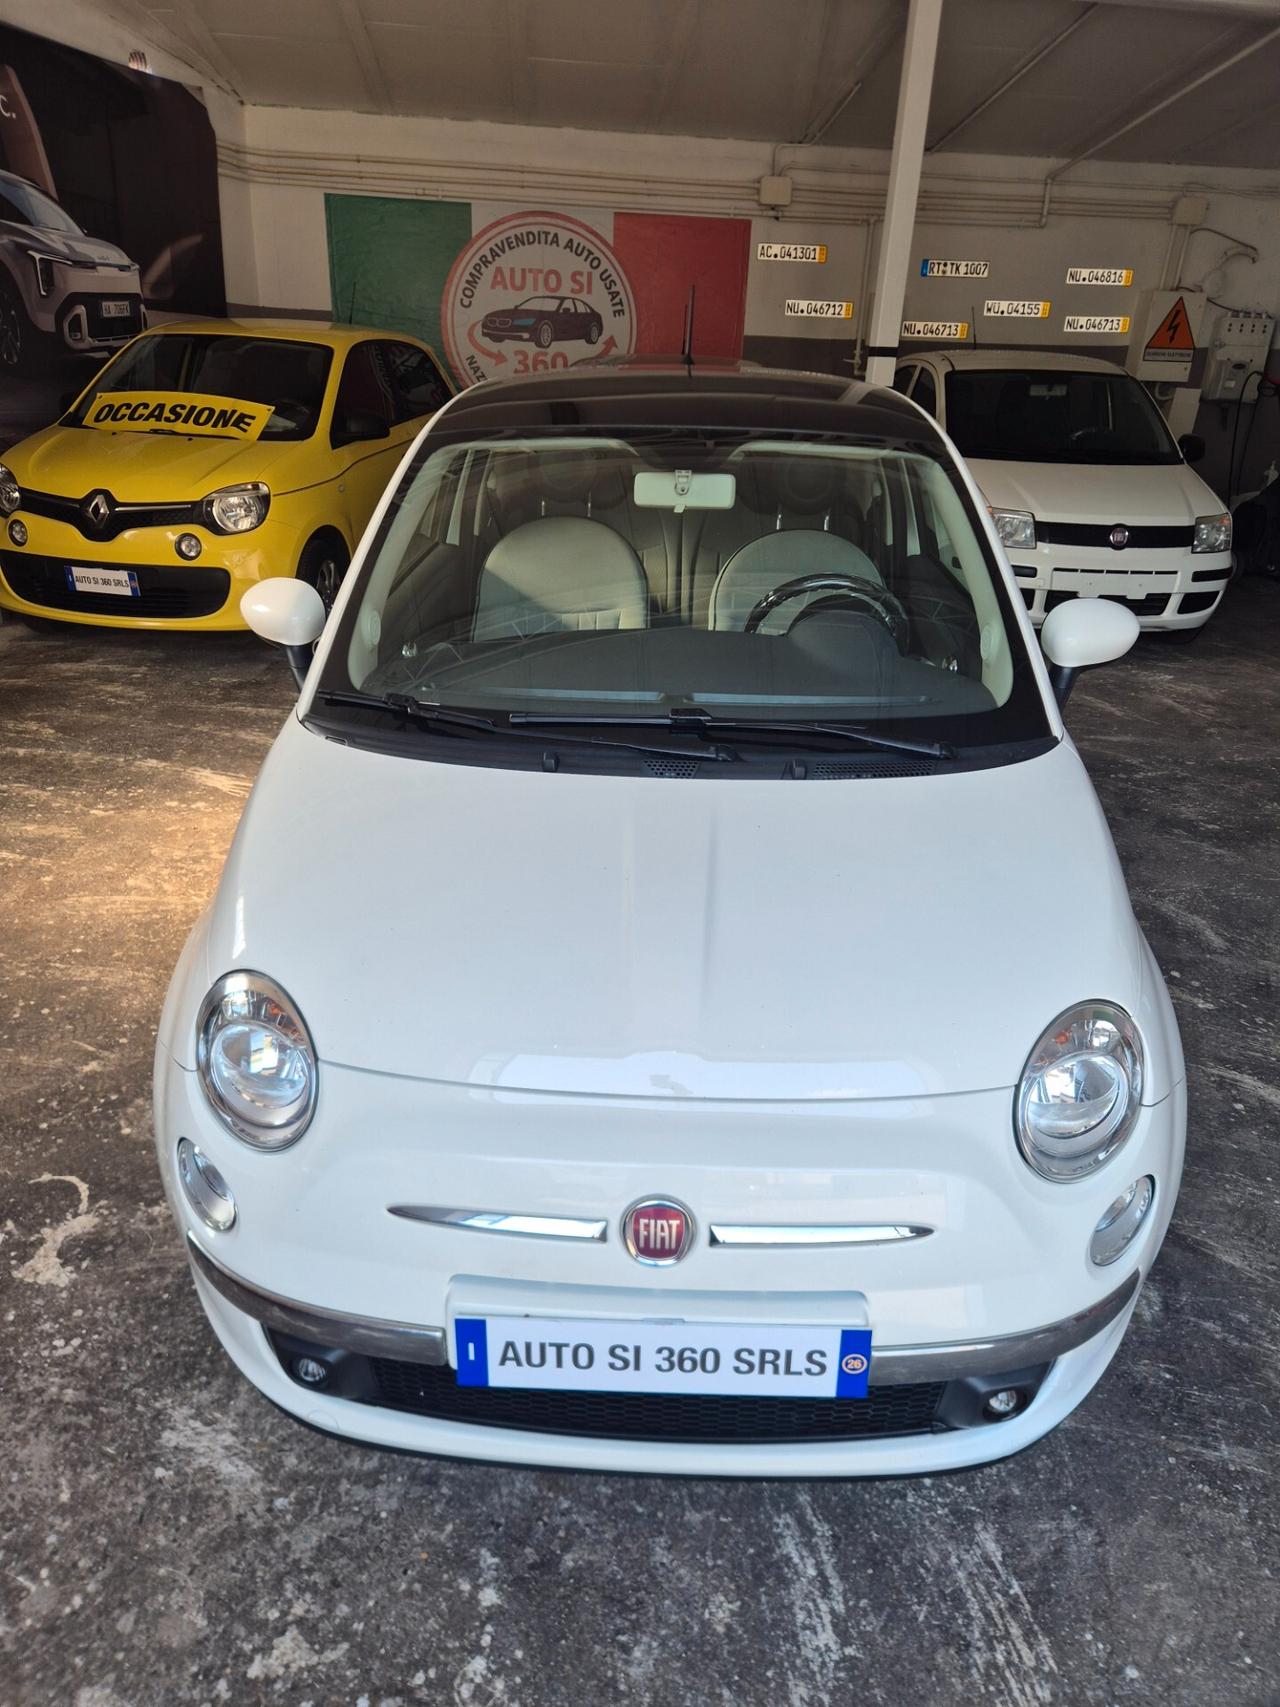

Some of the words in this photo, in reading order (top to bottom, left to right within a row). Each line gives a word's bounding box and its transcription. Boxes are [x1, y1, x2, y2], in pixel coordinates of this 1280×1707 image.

[460, 230, 560, 309] COMPRAVENDITA
[564, 238, 601, 270] AUTO
[599, 268, 625, 318] USATE
[490, 266, 562, 293] AUTO
[570, 270, 593, 295] SI
[963, 262, 988, 276] 1007
[513, 350, 569, 375] 360
[93, 402, 257, 433] OCCASIONE
[75, 575, 92, 585] AUTO
[92, 576, 99, 585] SI
[100, 577, 112, 586] 360
[113, 578, 130, 588] SRLS
[639, 1218, 680, 1249] FIAT
[498, 1340, 595, 1370] AUTO
[608, 1344, 641, 1371] SI
[655, 1346, 721, 1374] 360
[732, 1348, 828, 1376] SRLS
[846, 1358, 862, 1369] 26
